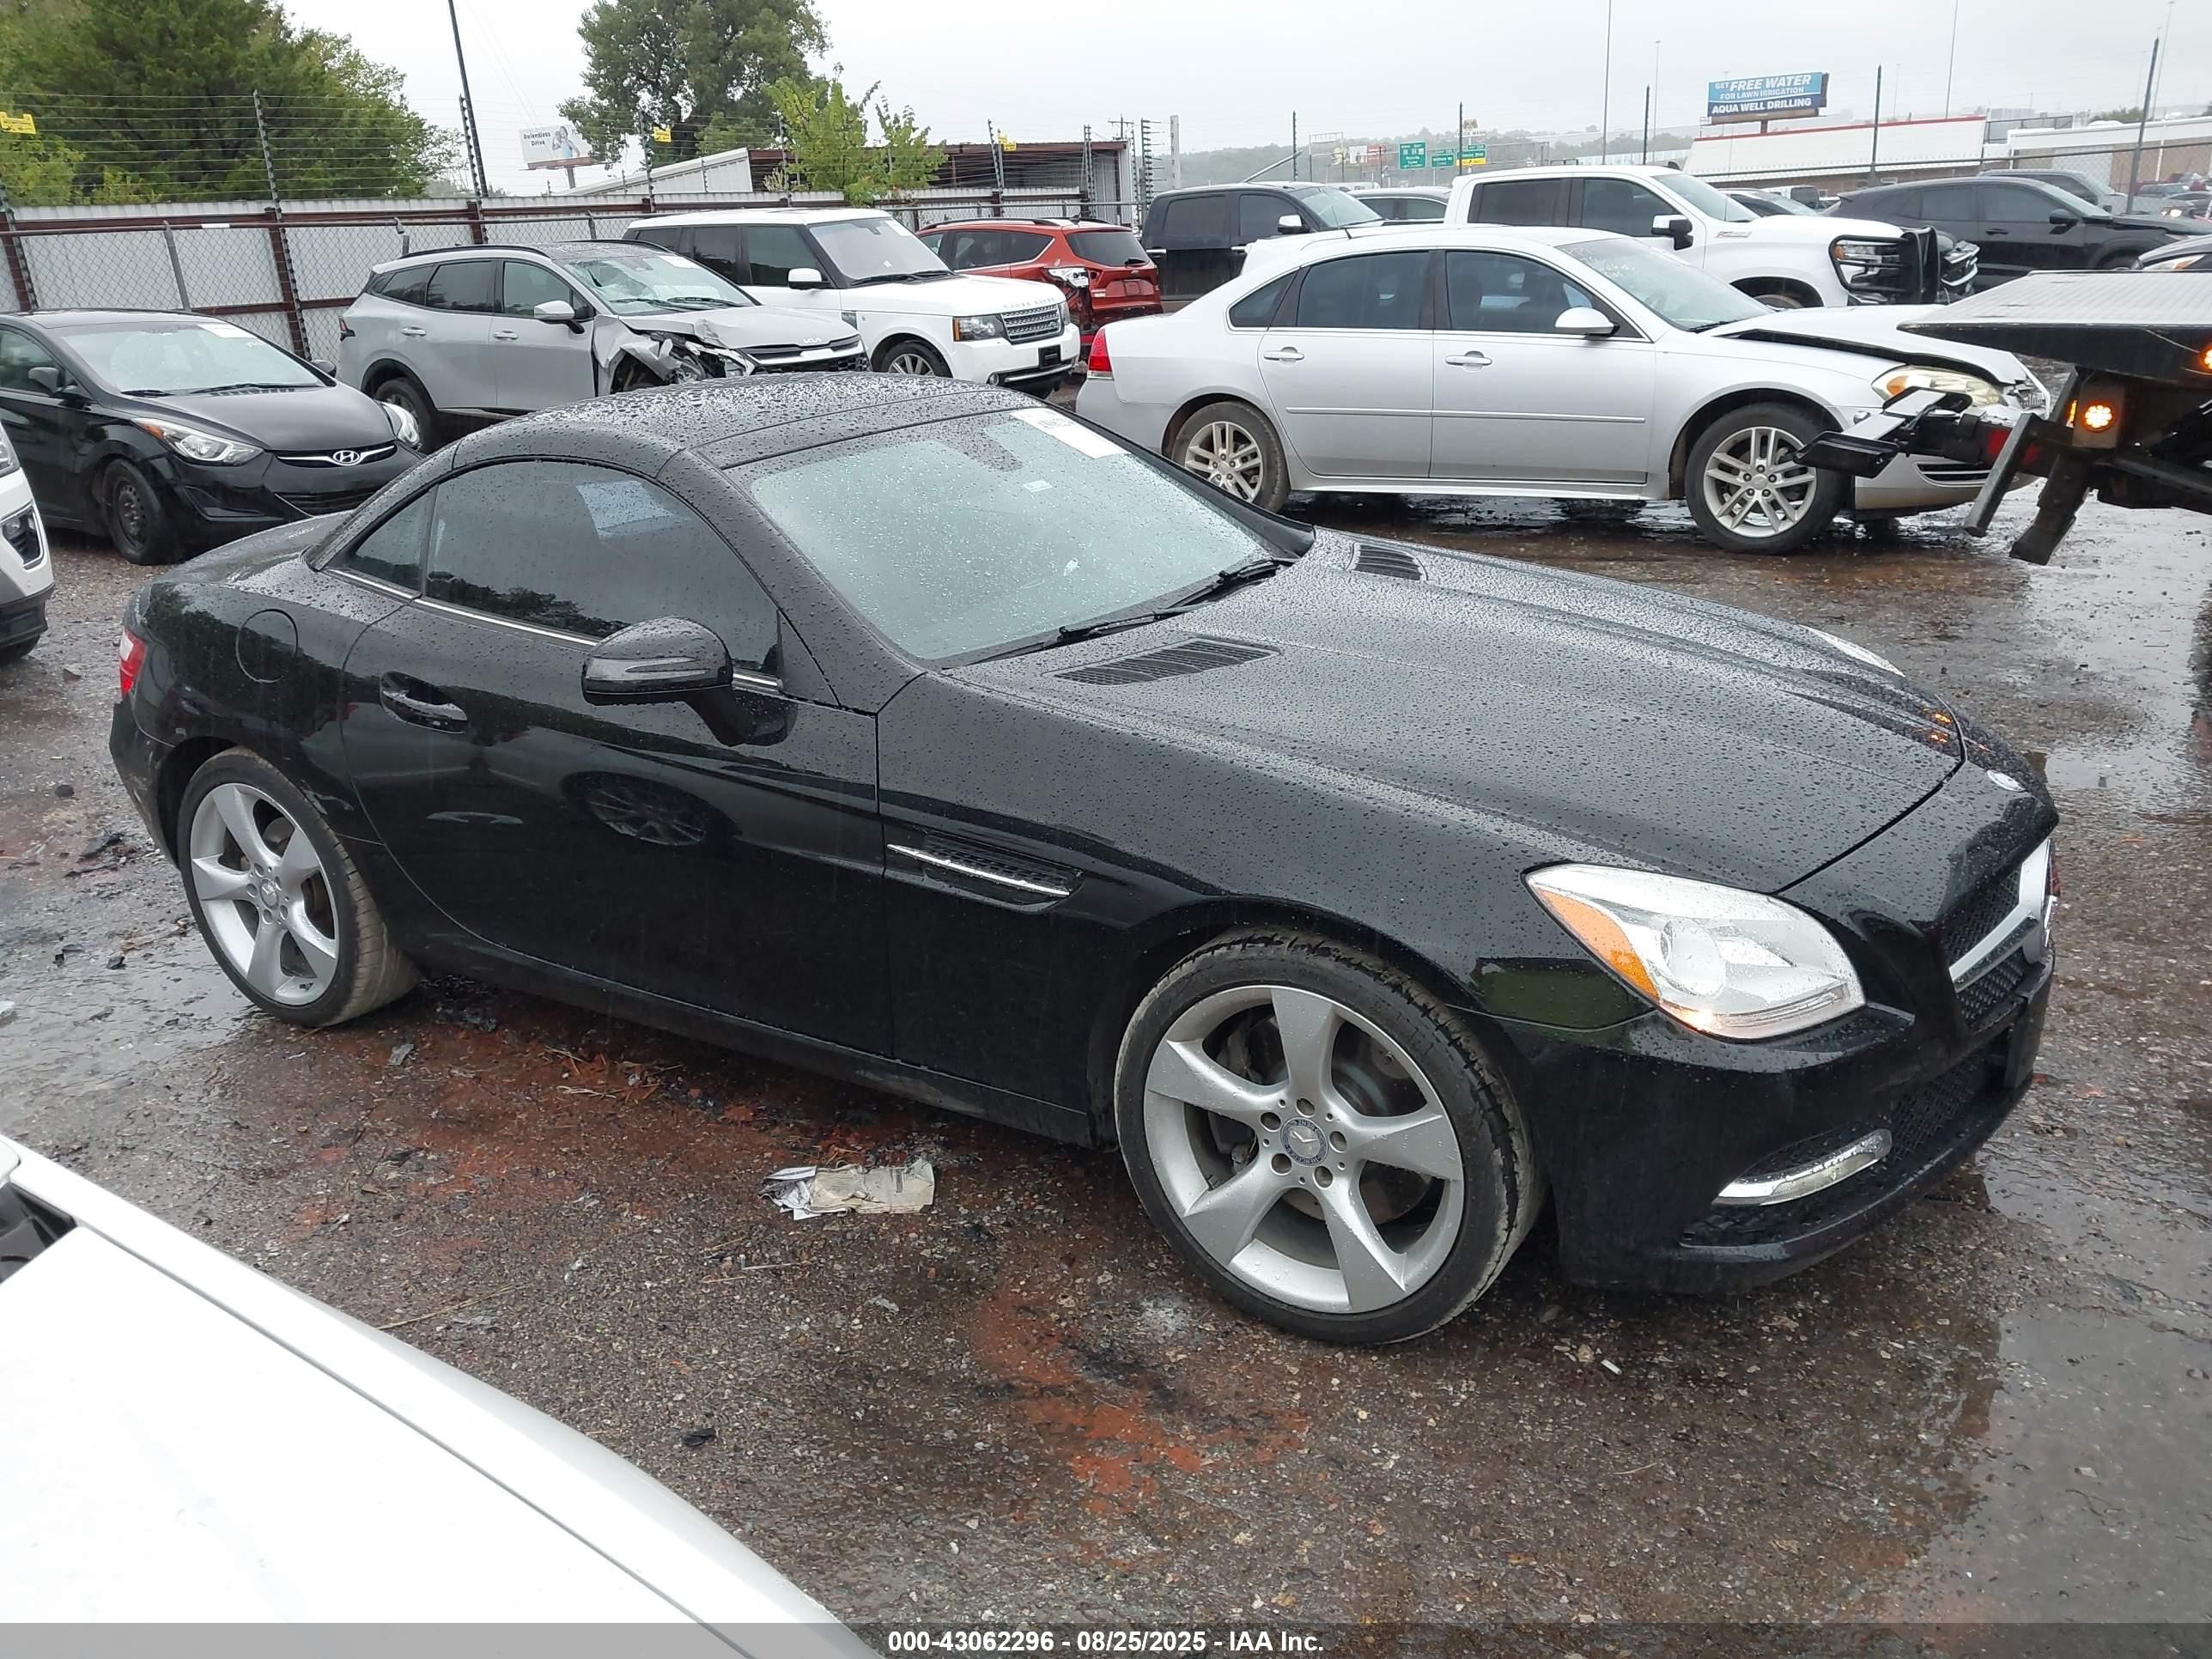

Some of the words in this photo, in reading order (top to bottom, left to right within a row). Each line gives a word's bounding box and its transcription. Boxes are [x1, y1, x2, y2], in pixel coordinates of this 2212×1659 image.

[1729, 78, 1764, 92] FREE
[1765, 74, 1812, 88] WATER
[1736, 88, 1759, 99] LAWN
[1760, 86, 1805, 97] IRRIGATION
[1711, 104, 1739, 114] AQUA
[1741, 101, 1765, 112] WELL
[1766, 97, 1812, 110] DRILLING
